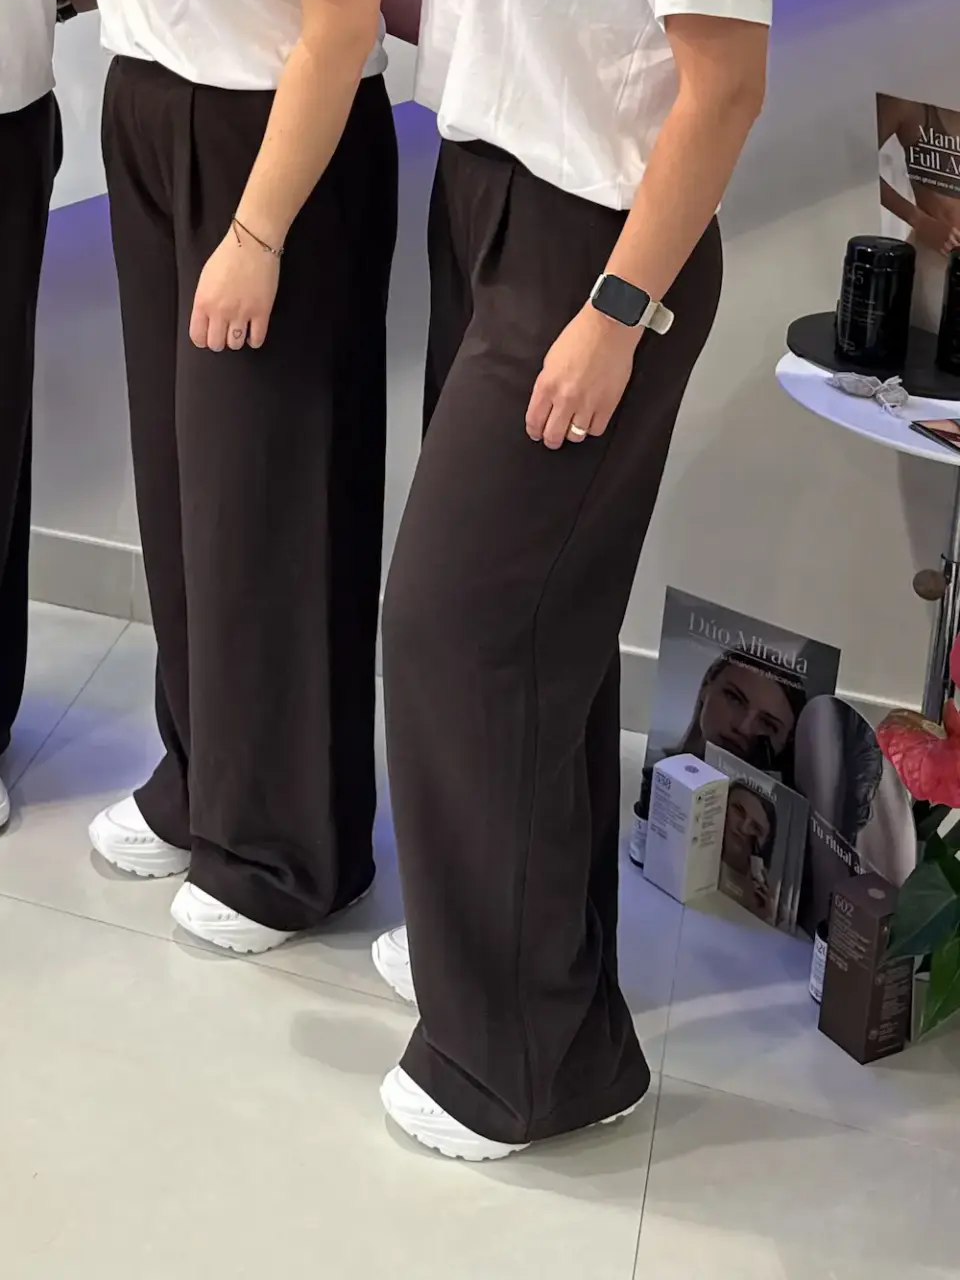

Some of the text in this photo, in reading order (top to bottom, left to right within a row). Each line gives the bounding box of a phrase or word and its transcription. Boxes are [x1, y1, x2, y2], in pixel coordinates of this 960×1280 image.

[909, 146, 940, 170] Full
[687, 612, 808, 674] Dúo Mirada
[810, 816, 824, 840] Tu
[825, 834, 853, 867] ritual
[834, 894, 855, 918] 602
